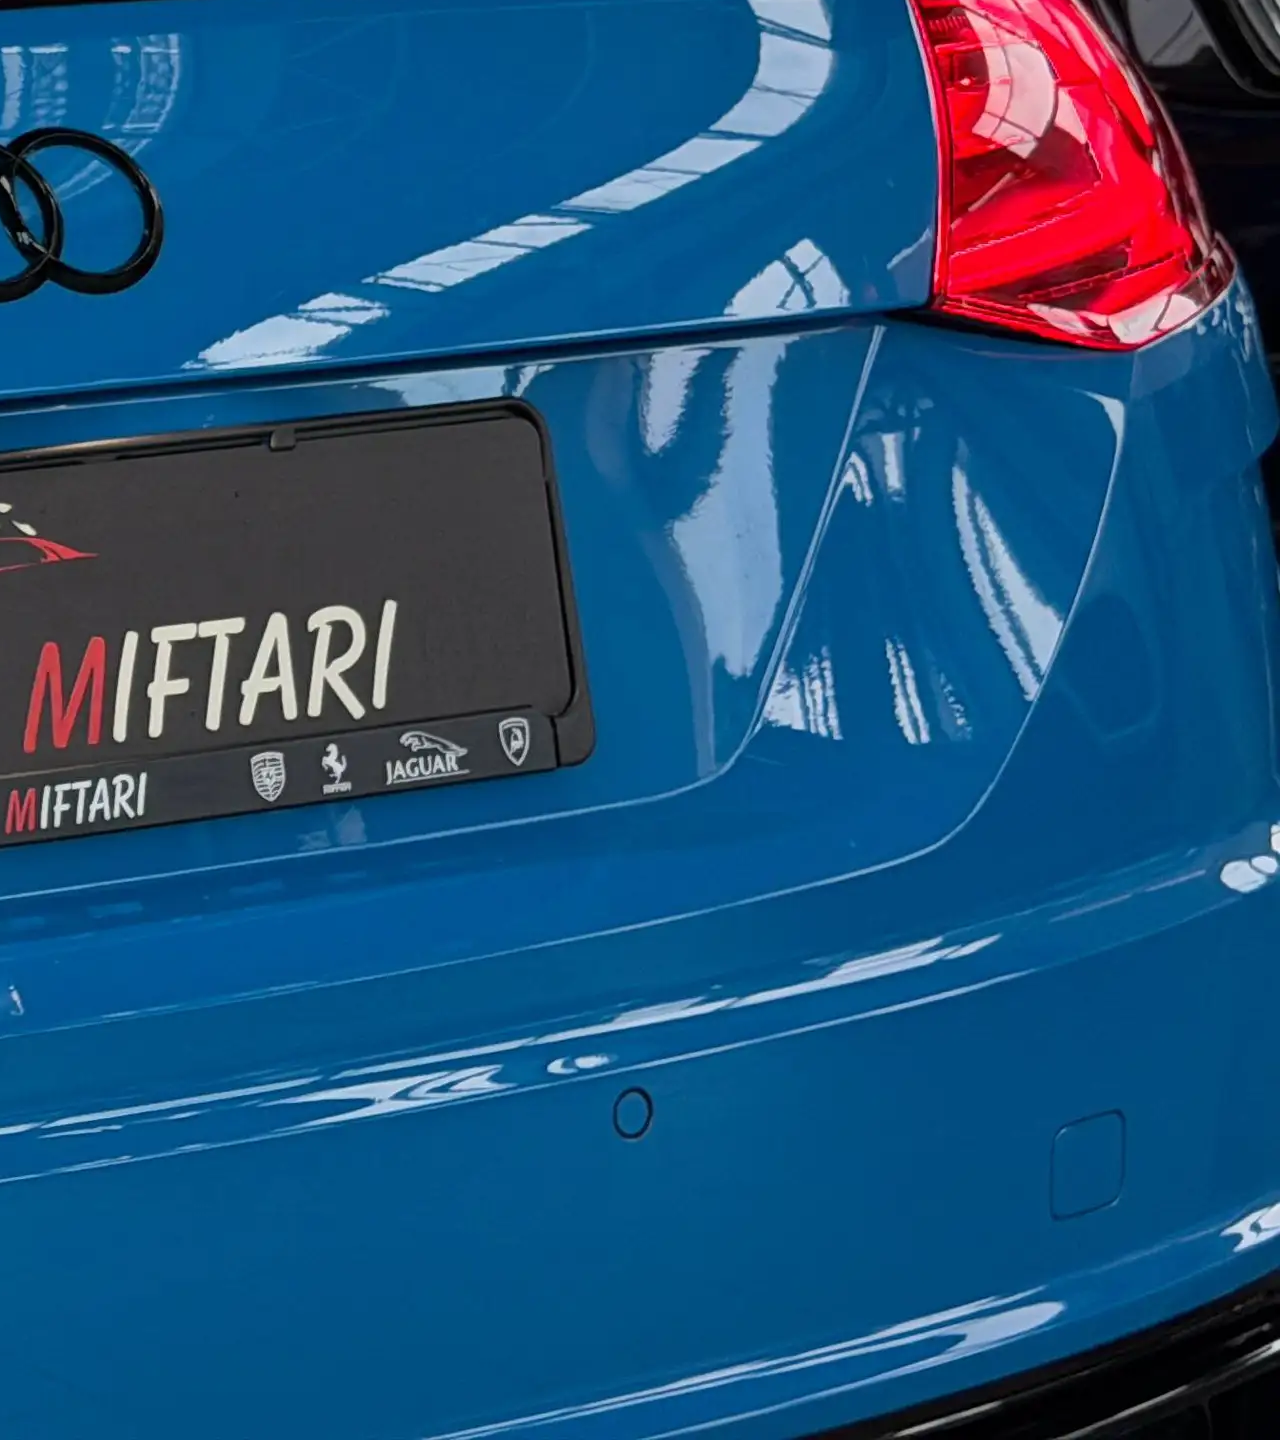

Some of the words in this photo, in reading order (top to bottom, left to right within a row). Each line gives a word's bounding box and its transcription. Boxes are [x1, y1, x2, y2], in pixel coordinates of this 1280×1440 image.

[21, 599, 398, 754] MIFTARI
[386, 753, 459, 785] JAGUAR
[4, 772, 147, 834] MIFTARI
